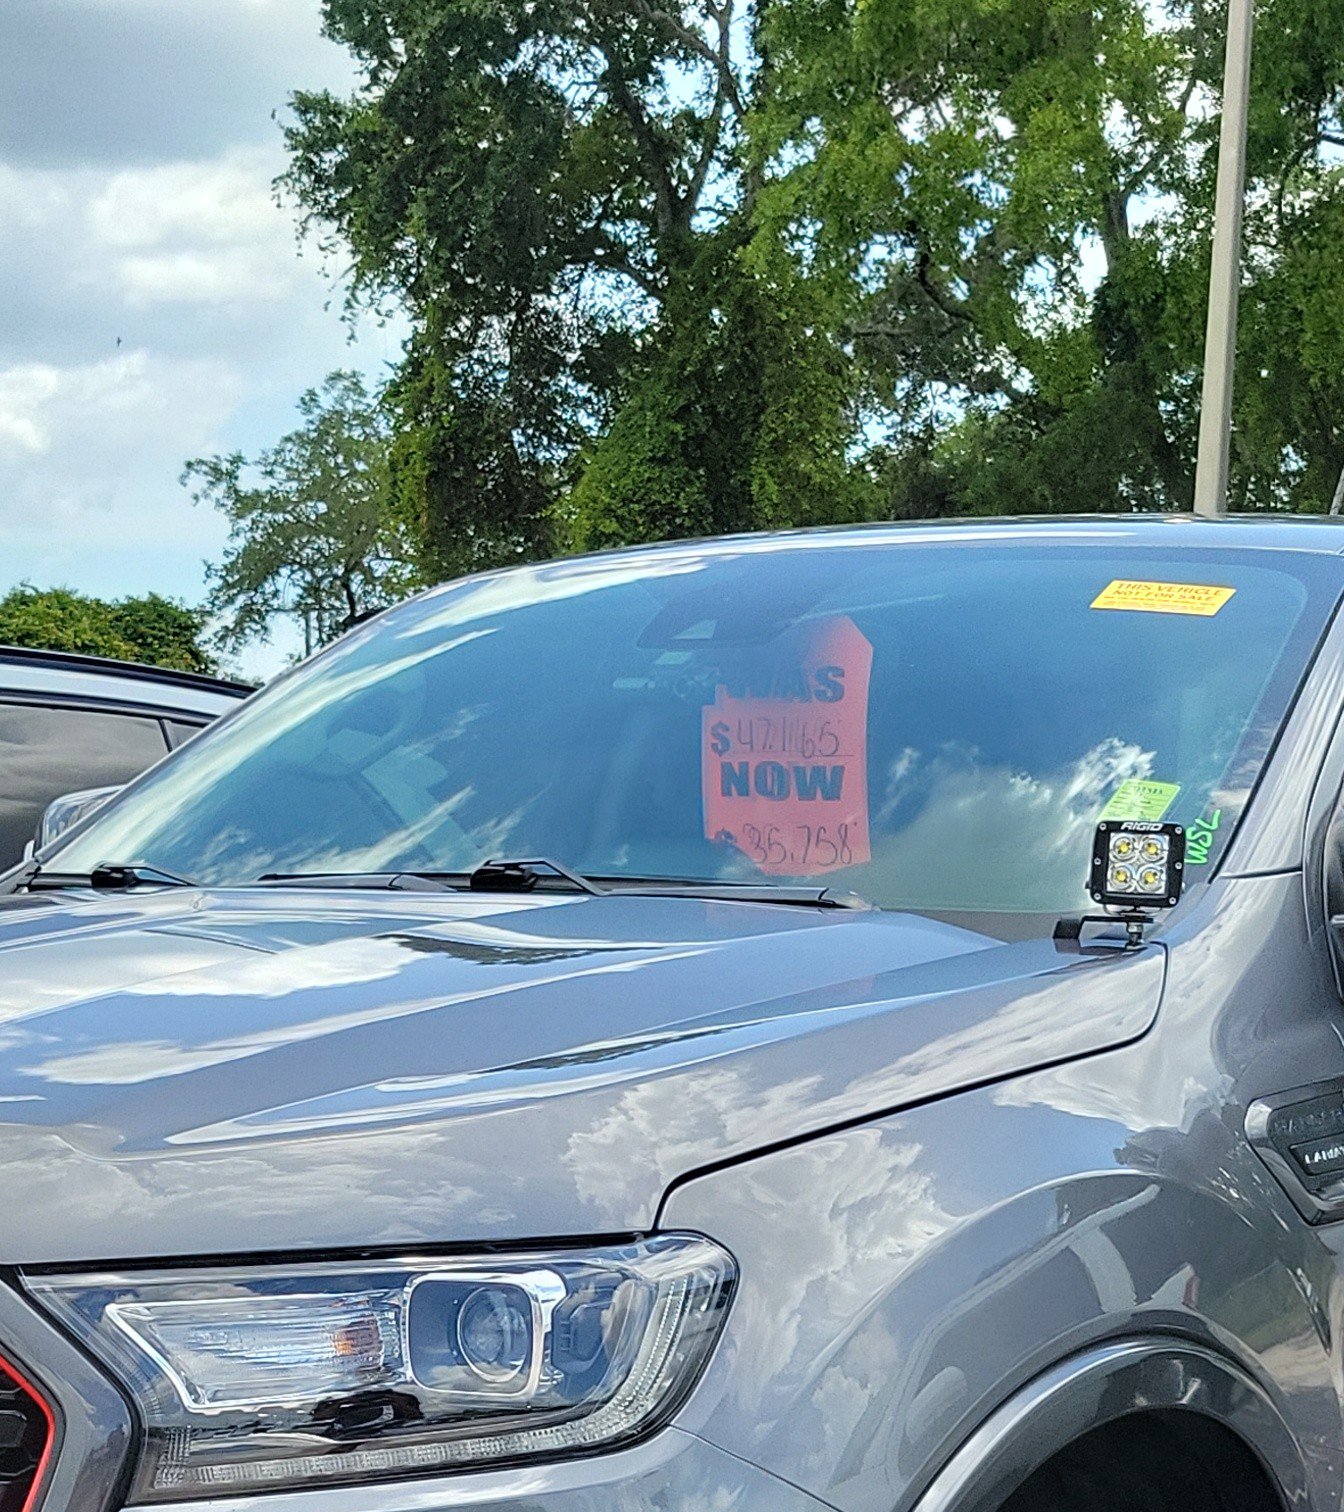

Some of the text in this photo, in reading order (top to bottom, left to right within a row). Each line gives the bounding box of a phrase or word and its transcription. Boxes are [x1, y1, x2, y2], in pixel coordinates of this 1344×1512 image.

[1113, 589, 1142, 597] NOT
[1178, 593, 1215, 602] SALE
[1117, 582, 1225, 597] THIS VEHICLE
[721, 760, 845, 802] NOW
[1120, 821, 1164, 831] RIGID
